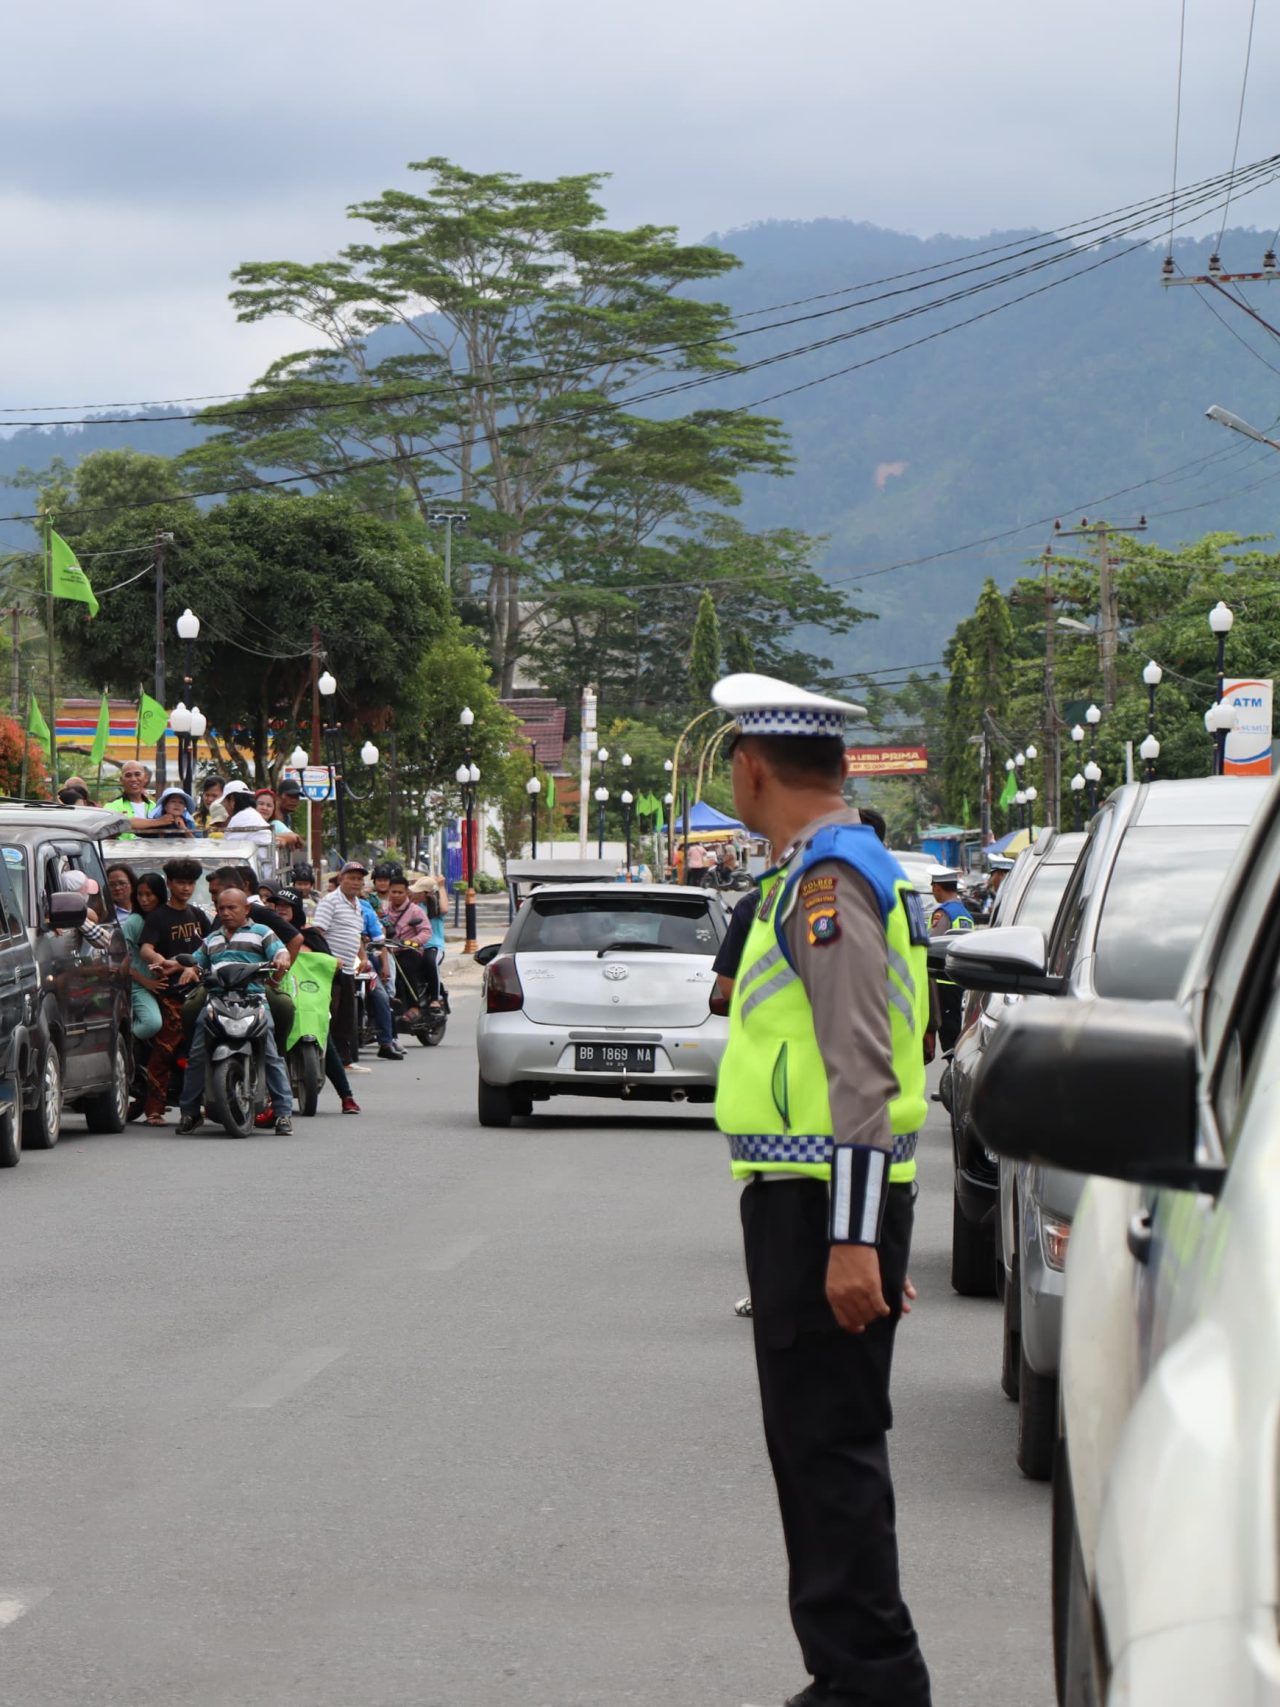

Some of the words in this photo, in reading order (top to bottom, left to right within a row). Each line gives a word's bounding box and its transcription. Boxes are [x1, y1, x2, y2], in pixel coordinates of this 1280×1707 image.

[1233, 698, 1262, 707] ATM
[881, 752, 920, 761] PRIMA
[171, 922, 202, 940] FAITH
[580, 1047, 594, 1060] BB
[602, 1047, 628, 1061] 1869
[637, 1048, 651, 1061] NA
